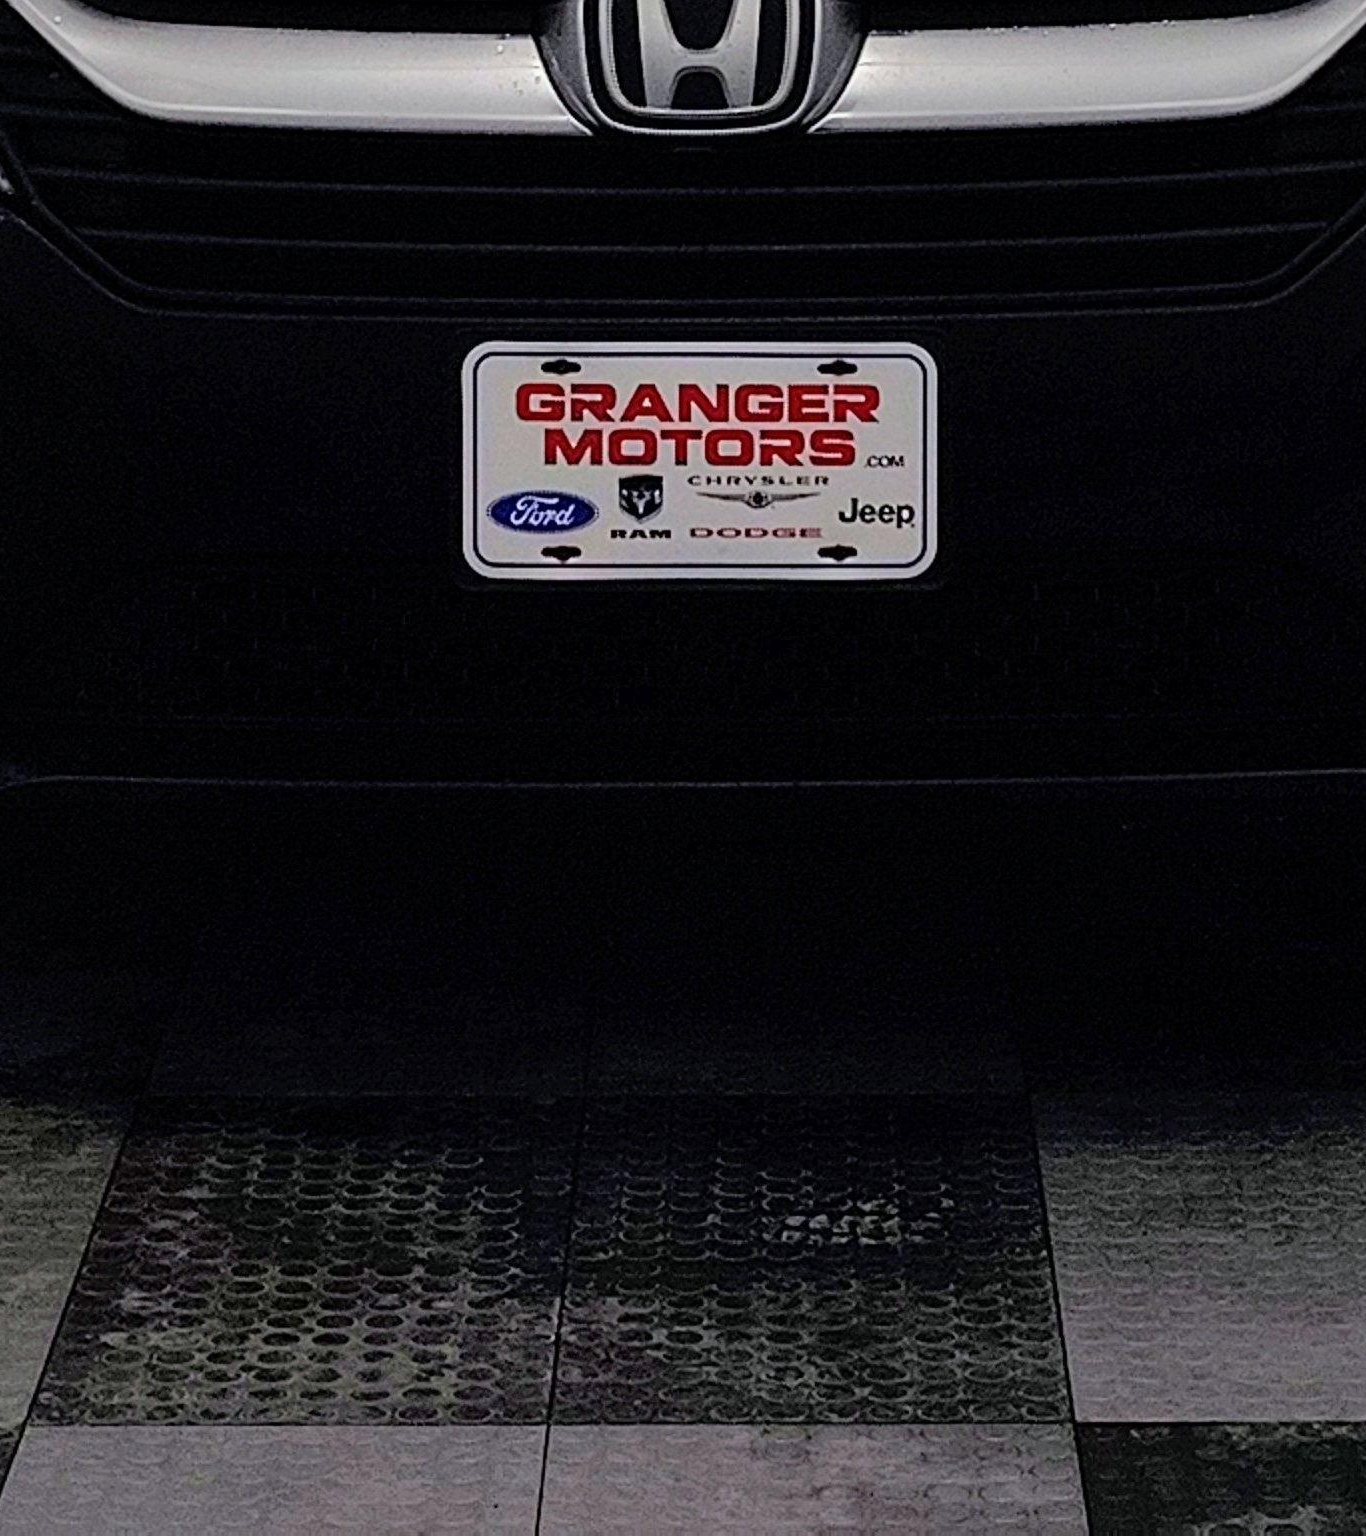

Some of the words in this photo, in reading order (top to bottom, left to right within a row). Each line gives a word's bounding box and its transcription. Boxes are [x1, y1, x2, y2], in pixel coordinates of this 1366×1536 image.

[515, 383, 880, 423] GRANGER
[543, 429, 856, 466] MOTORS
[687, 475, 830, 486] CHRYSLER
[510, 495, 575, 527] Ford
[838, 498, 915, 528] Jeep
[610, 529, 672, 539] RAM
[690, 528, 823, 538] DODGE
